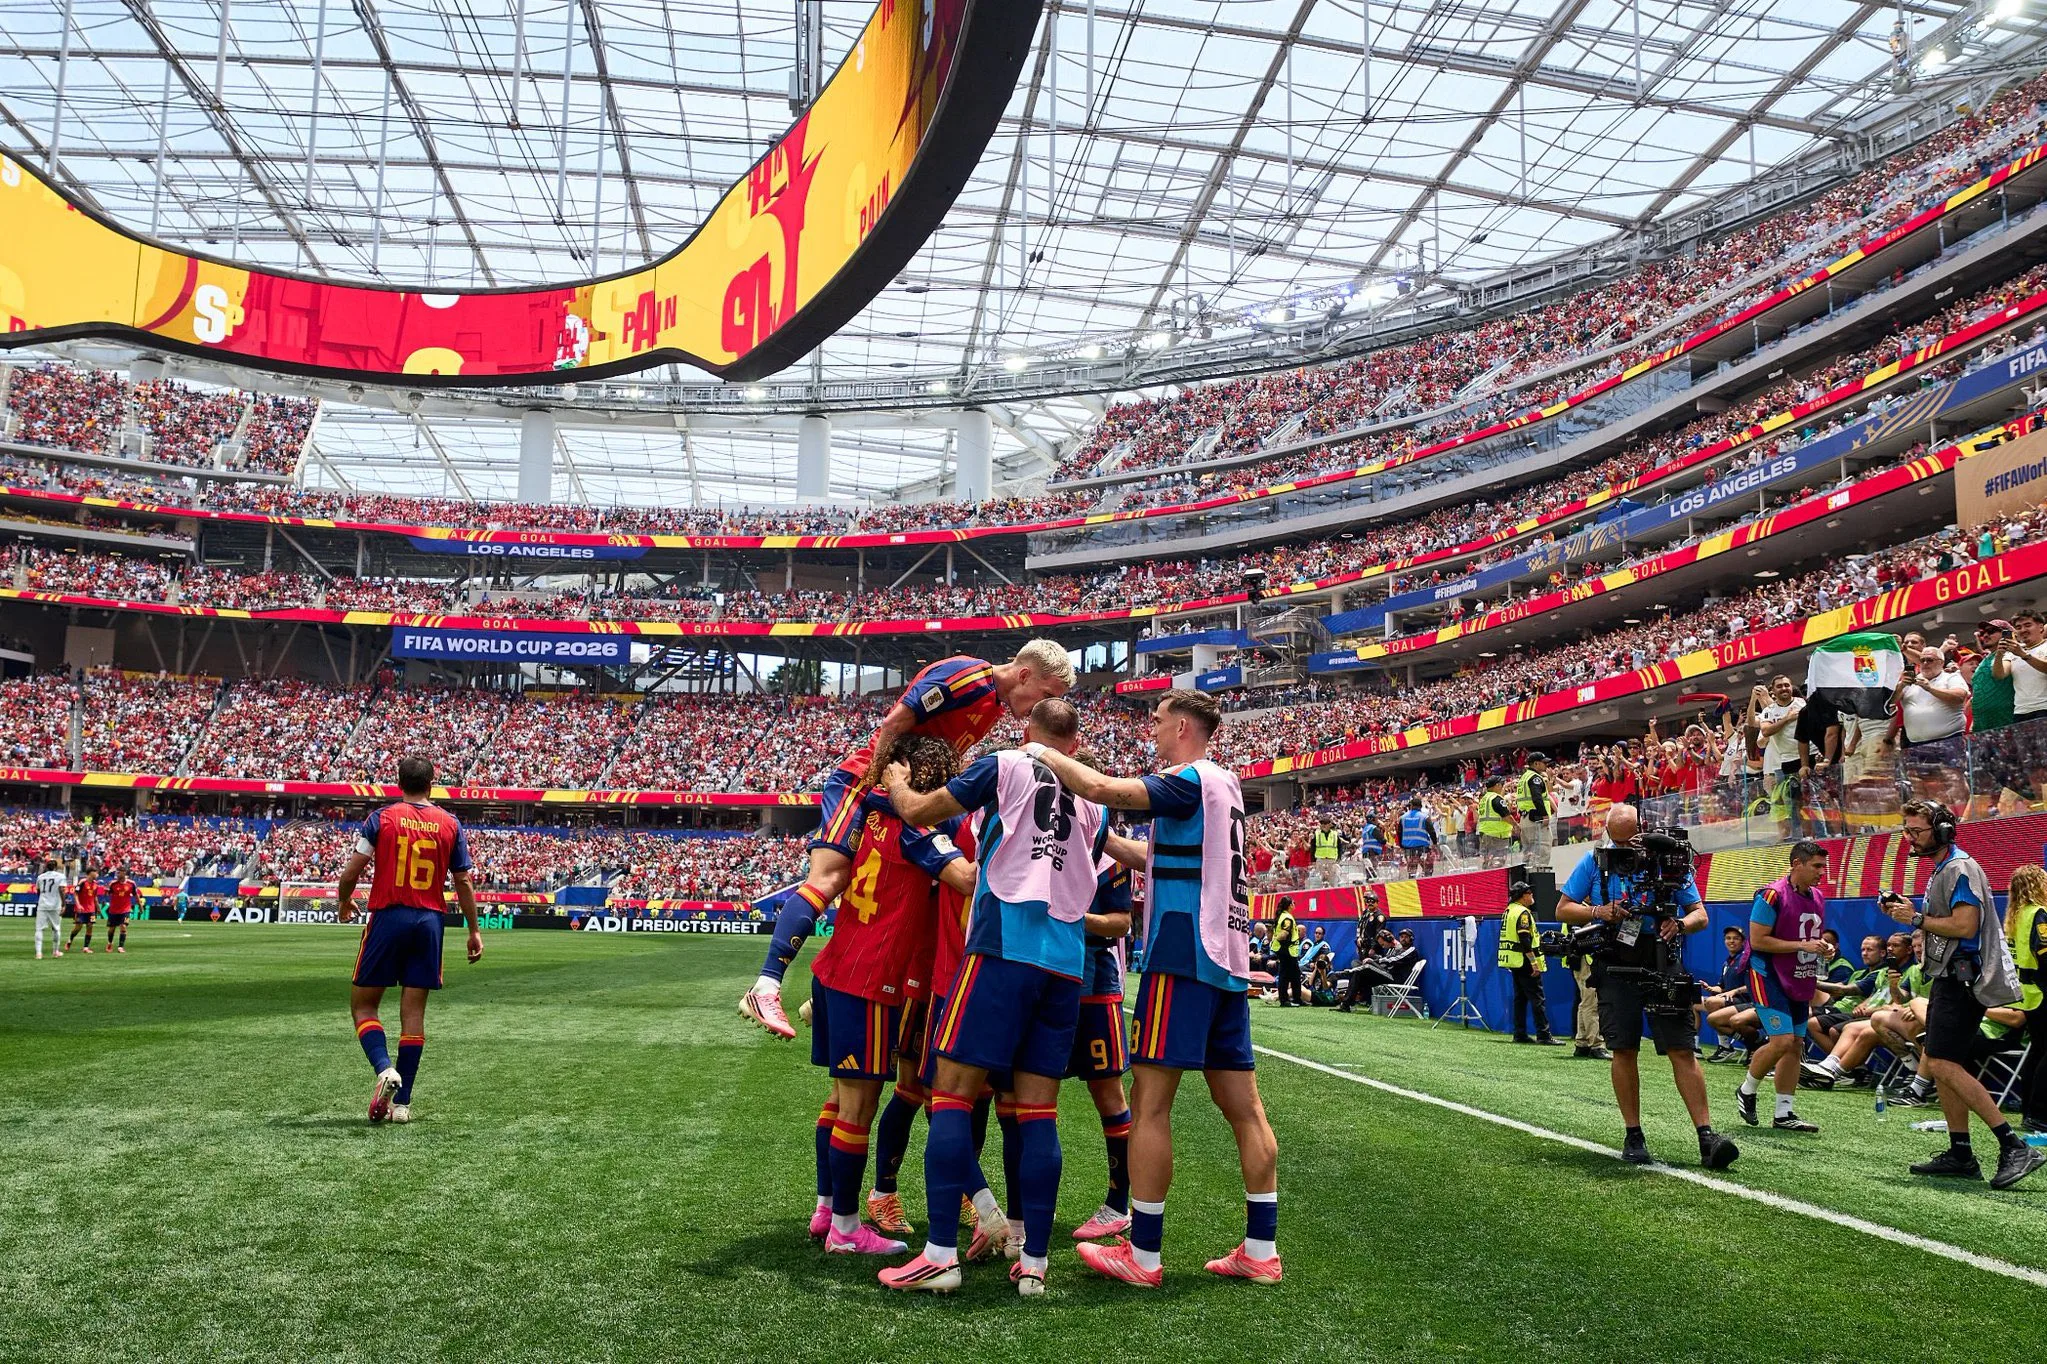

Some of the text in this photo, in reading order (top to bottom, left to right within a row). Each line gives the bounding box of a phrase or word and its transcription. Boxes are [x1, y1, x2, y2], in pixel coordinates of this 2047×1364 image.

[2009, 348, 2047, 378] FIFA
[1669, 456, 1798, 518] LOS ANGELES
[520, 534, 556, 543] GOAL
[695, 538, 729, 547] GOAL
[467, 544, 594, 559] LOS ANGELES
[1632, 560, 1667, 580] GOAL
[1936, 559, 2011, 601] GOAL
[1501, 605, 1531, 623] GOAL
[483, 619, 520, 629] GOAL
[695, 624, 730, 633] GOAL
[404, 635, 618, 656] FIFA WORLD CUP 2026
[1383, 639, 1416, 654] GOAL
[1711, 637, 1760, 666] GOAL
[1123, 683, 1144, 693] GOAL
[1426, 722, 1454, 741] GOAL
[1322, 748, 1347, 763] GOAL
[0, 770, 31, 780] OAL
[1240, 766, 1256, 779] OAL
[460, 790, 499, 800] GOAL
[674, 795, 712, 804] GOAL
[400, 817, 440, 833] RODRIGO
[395, 835, 438, 890] 16
[42, 878, 55, 893] 17
[1440, 885, 1468, 907] GOAL
[224, 907, 271, 923] ADI
[464, 913, 514, 929] alshi
[584, 917, 761, 934] ADI PREDICTSTREET
[1090, 1039, 1109, 1071] 9
